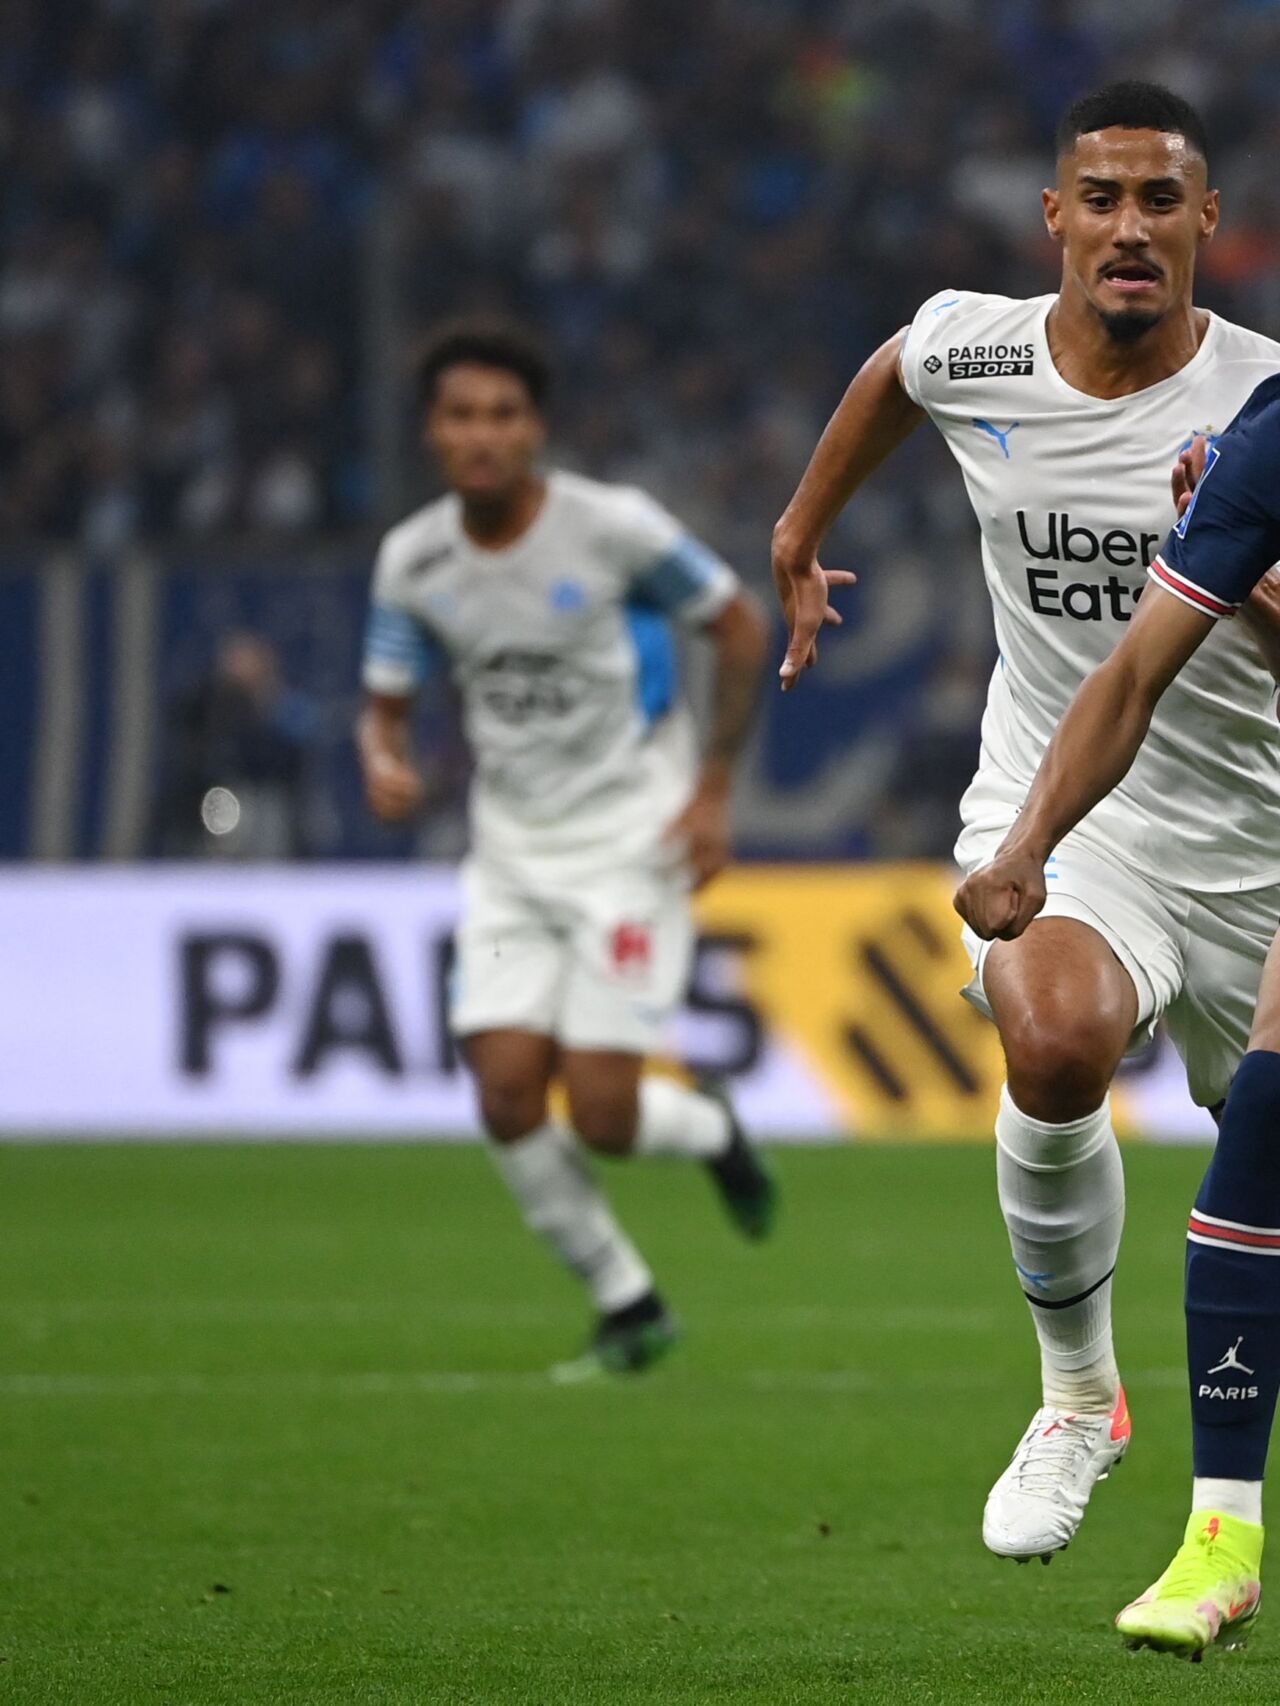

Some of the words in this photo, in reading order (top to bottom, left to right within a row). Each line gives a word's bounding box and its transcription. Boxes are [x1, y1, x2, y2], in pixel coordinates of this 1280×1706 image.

[948, 344, 1034, 362] PARIONS
[951, 362, 1032, 378] SPORT
[1016, 510, 1159, 567] Uber
[1026, 567, 1145, 621] Eat
[1198, 1384, 1259, 1400] PARIS
